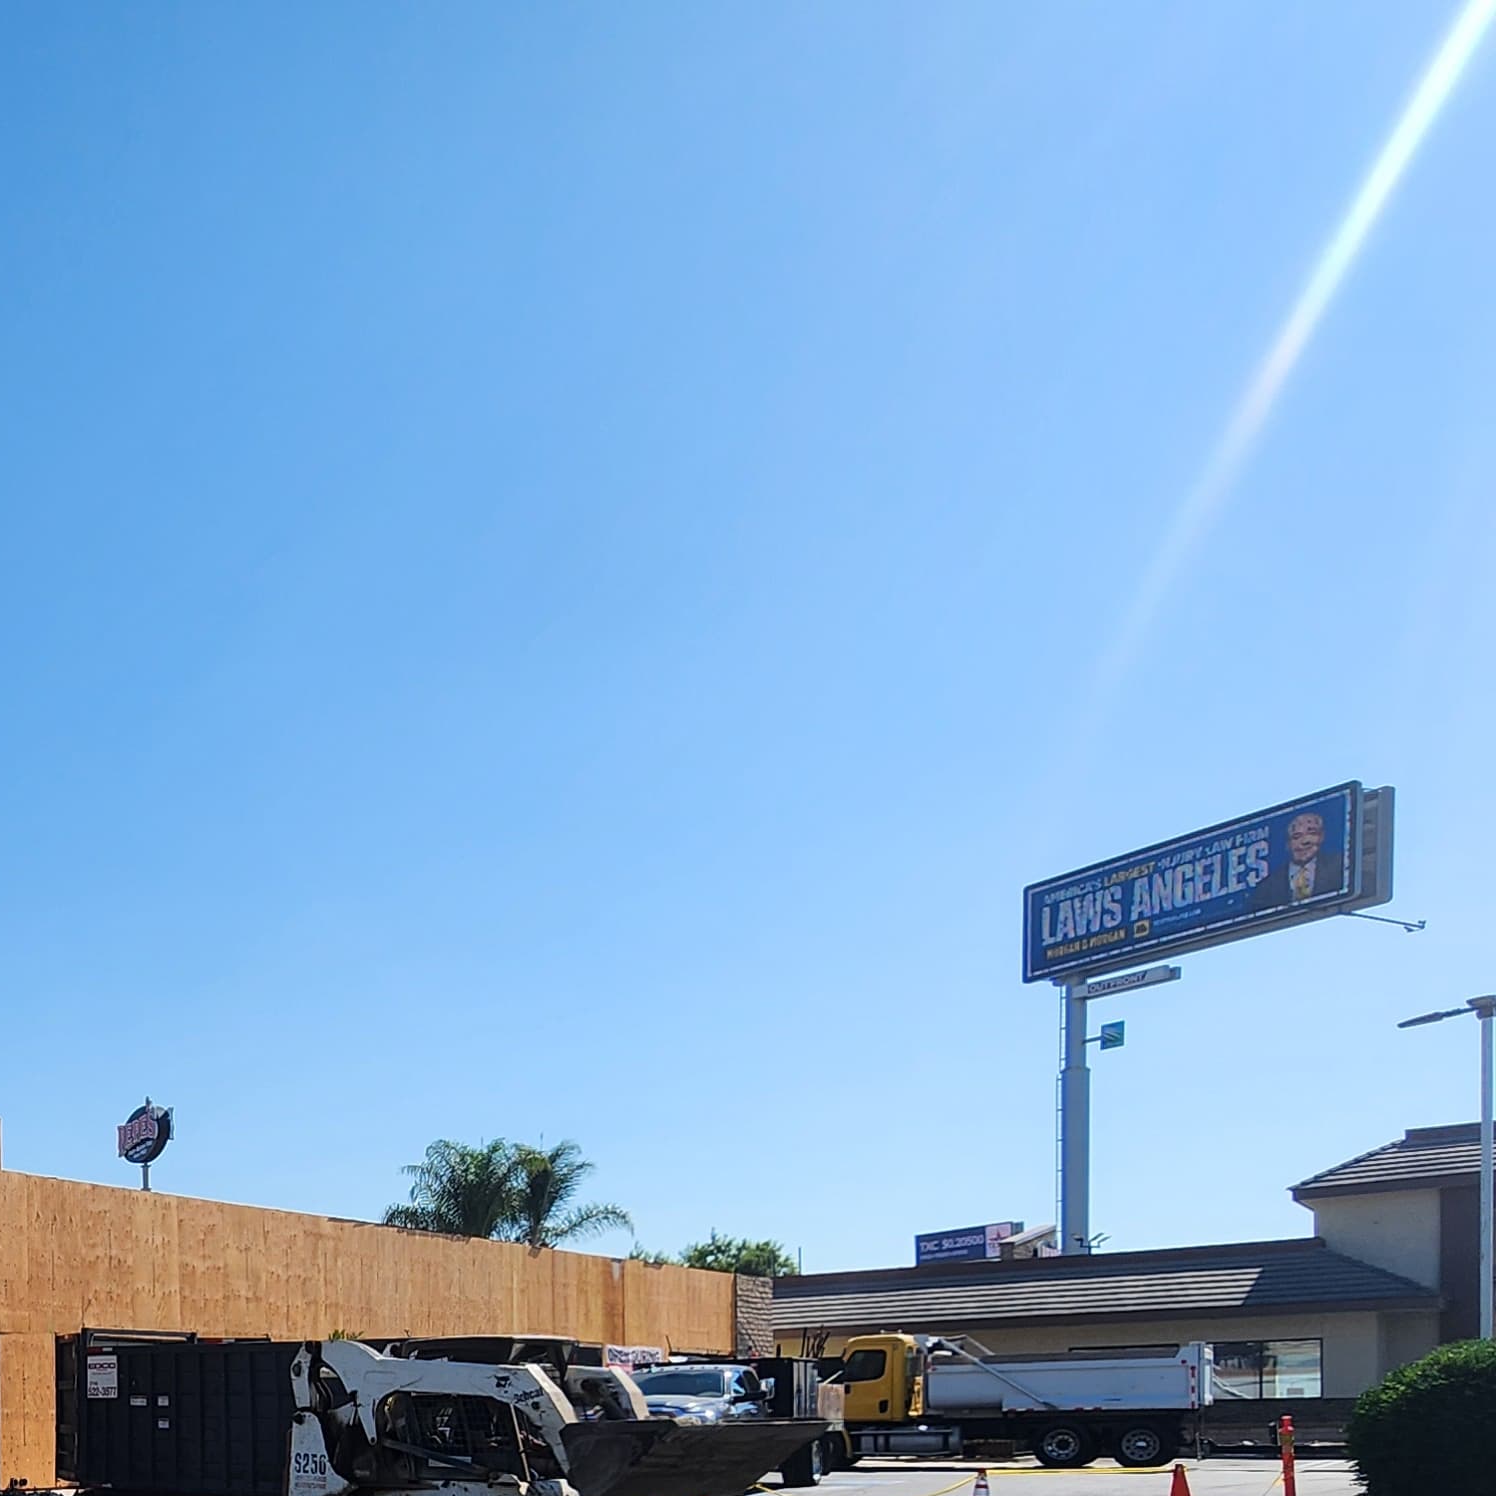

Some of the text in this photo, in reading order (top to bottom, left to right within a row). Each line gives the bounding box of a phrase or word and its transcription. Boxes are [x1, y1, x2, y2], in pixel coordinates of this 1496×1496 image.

[1041, 840, 1270, 946] LAWS ANGELES
[1103, 861, 1156, 887] LARGEST
[1205, 835, 1234, 856] LAW
[1236, 826, 1270, 847] FIRM
